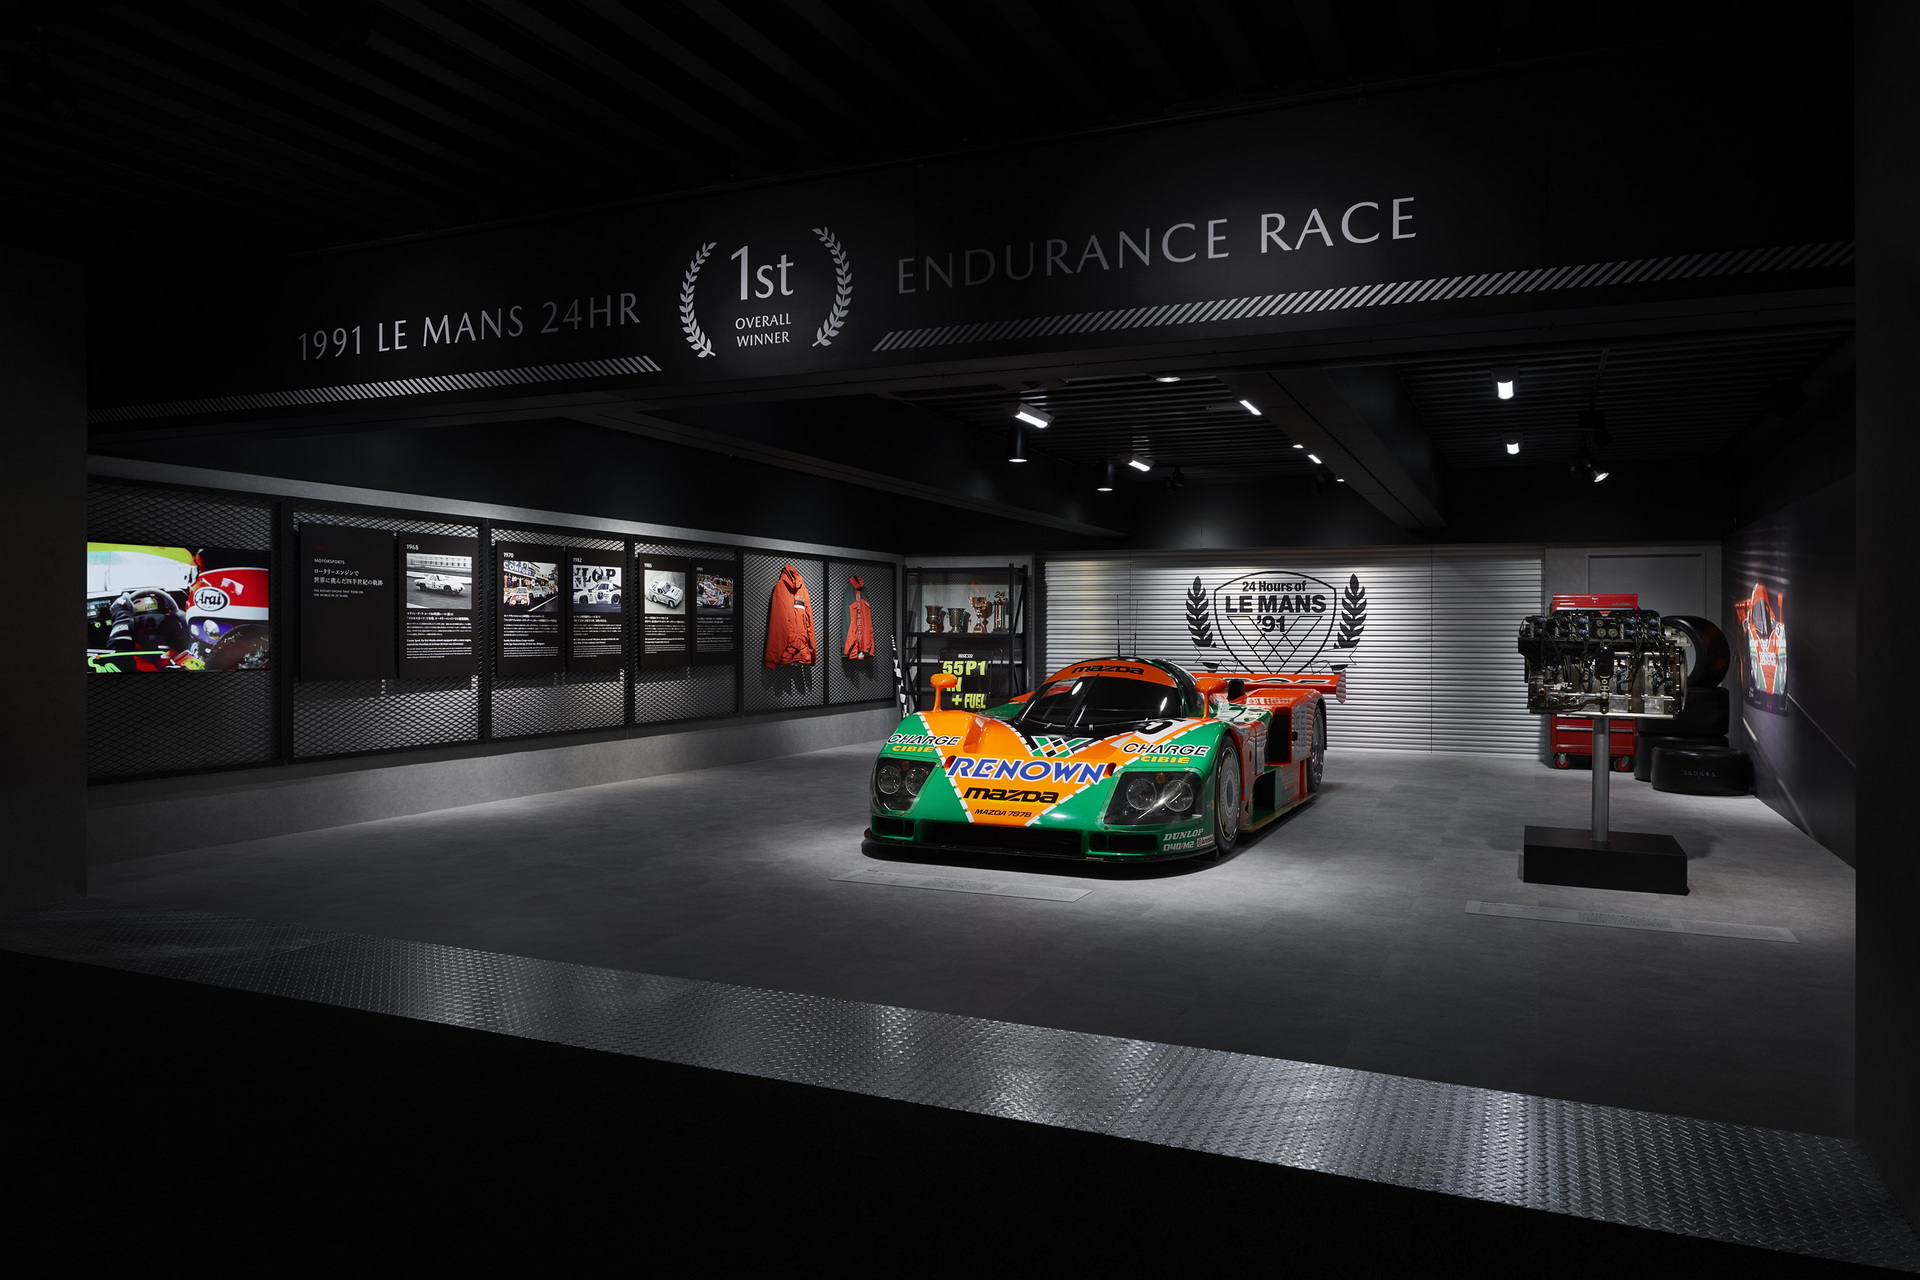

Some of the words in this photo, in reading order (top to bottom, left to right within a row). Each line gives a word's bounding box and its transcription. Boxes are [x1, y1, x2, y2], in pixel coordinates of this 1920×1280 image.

[897, 218, 1229, 295] ENDURANCE
[1260, 196, 1417, 254] RACE
[730, 245, 795, 301] 1st
[297, 325, 362, 361] 1991
[378, 320, 408, 352] LE
[422, 305, 525, 347] MANS
[540, 292, 642, 334] 24HR
[735, 312, 791, 330] OVERALL
[737, 331, 790, 348] WINNER
[314, 568, 360, 577] ロータリーエンジンで
[1242, 582, 1256, 592] 24
[1259, 581, 1293, 592] Hours
[1295, 580, 1307, 592] of
[195, 591, 222, 605] Arai
[1225, 595, 1252, 613] LE
[1258, 595, 1326, 613] MANS
[964, 693, 987, 709] FUEL
[887, 734, 963, 746] CHARGE
[1122, 743, 1210, 757] CHARGE
[947, 756, 1105, 785] RENOWN
[963, 787, 1059, 804] mazda
[1162, 828, 1205, 842] DUNLOP
